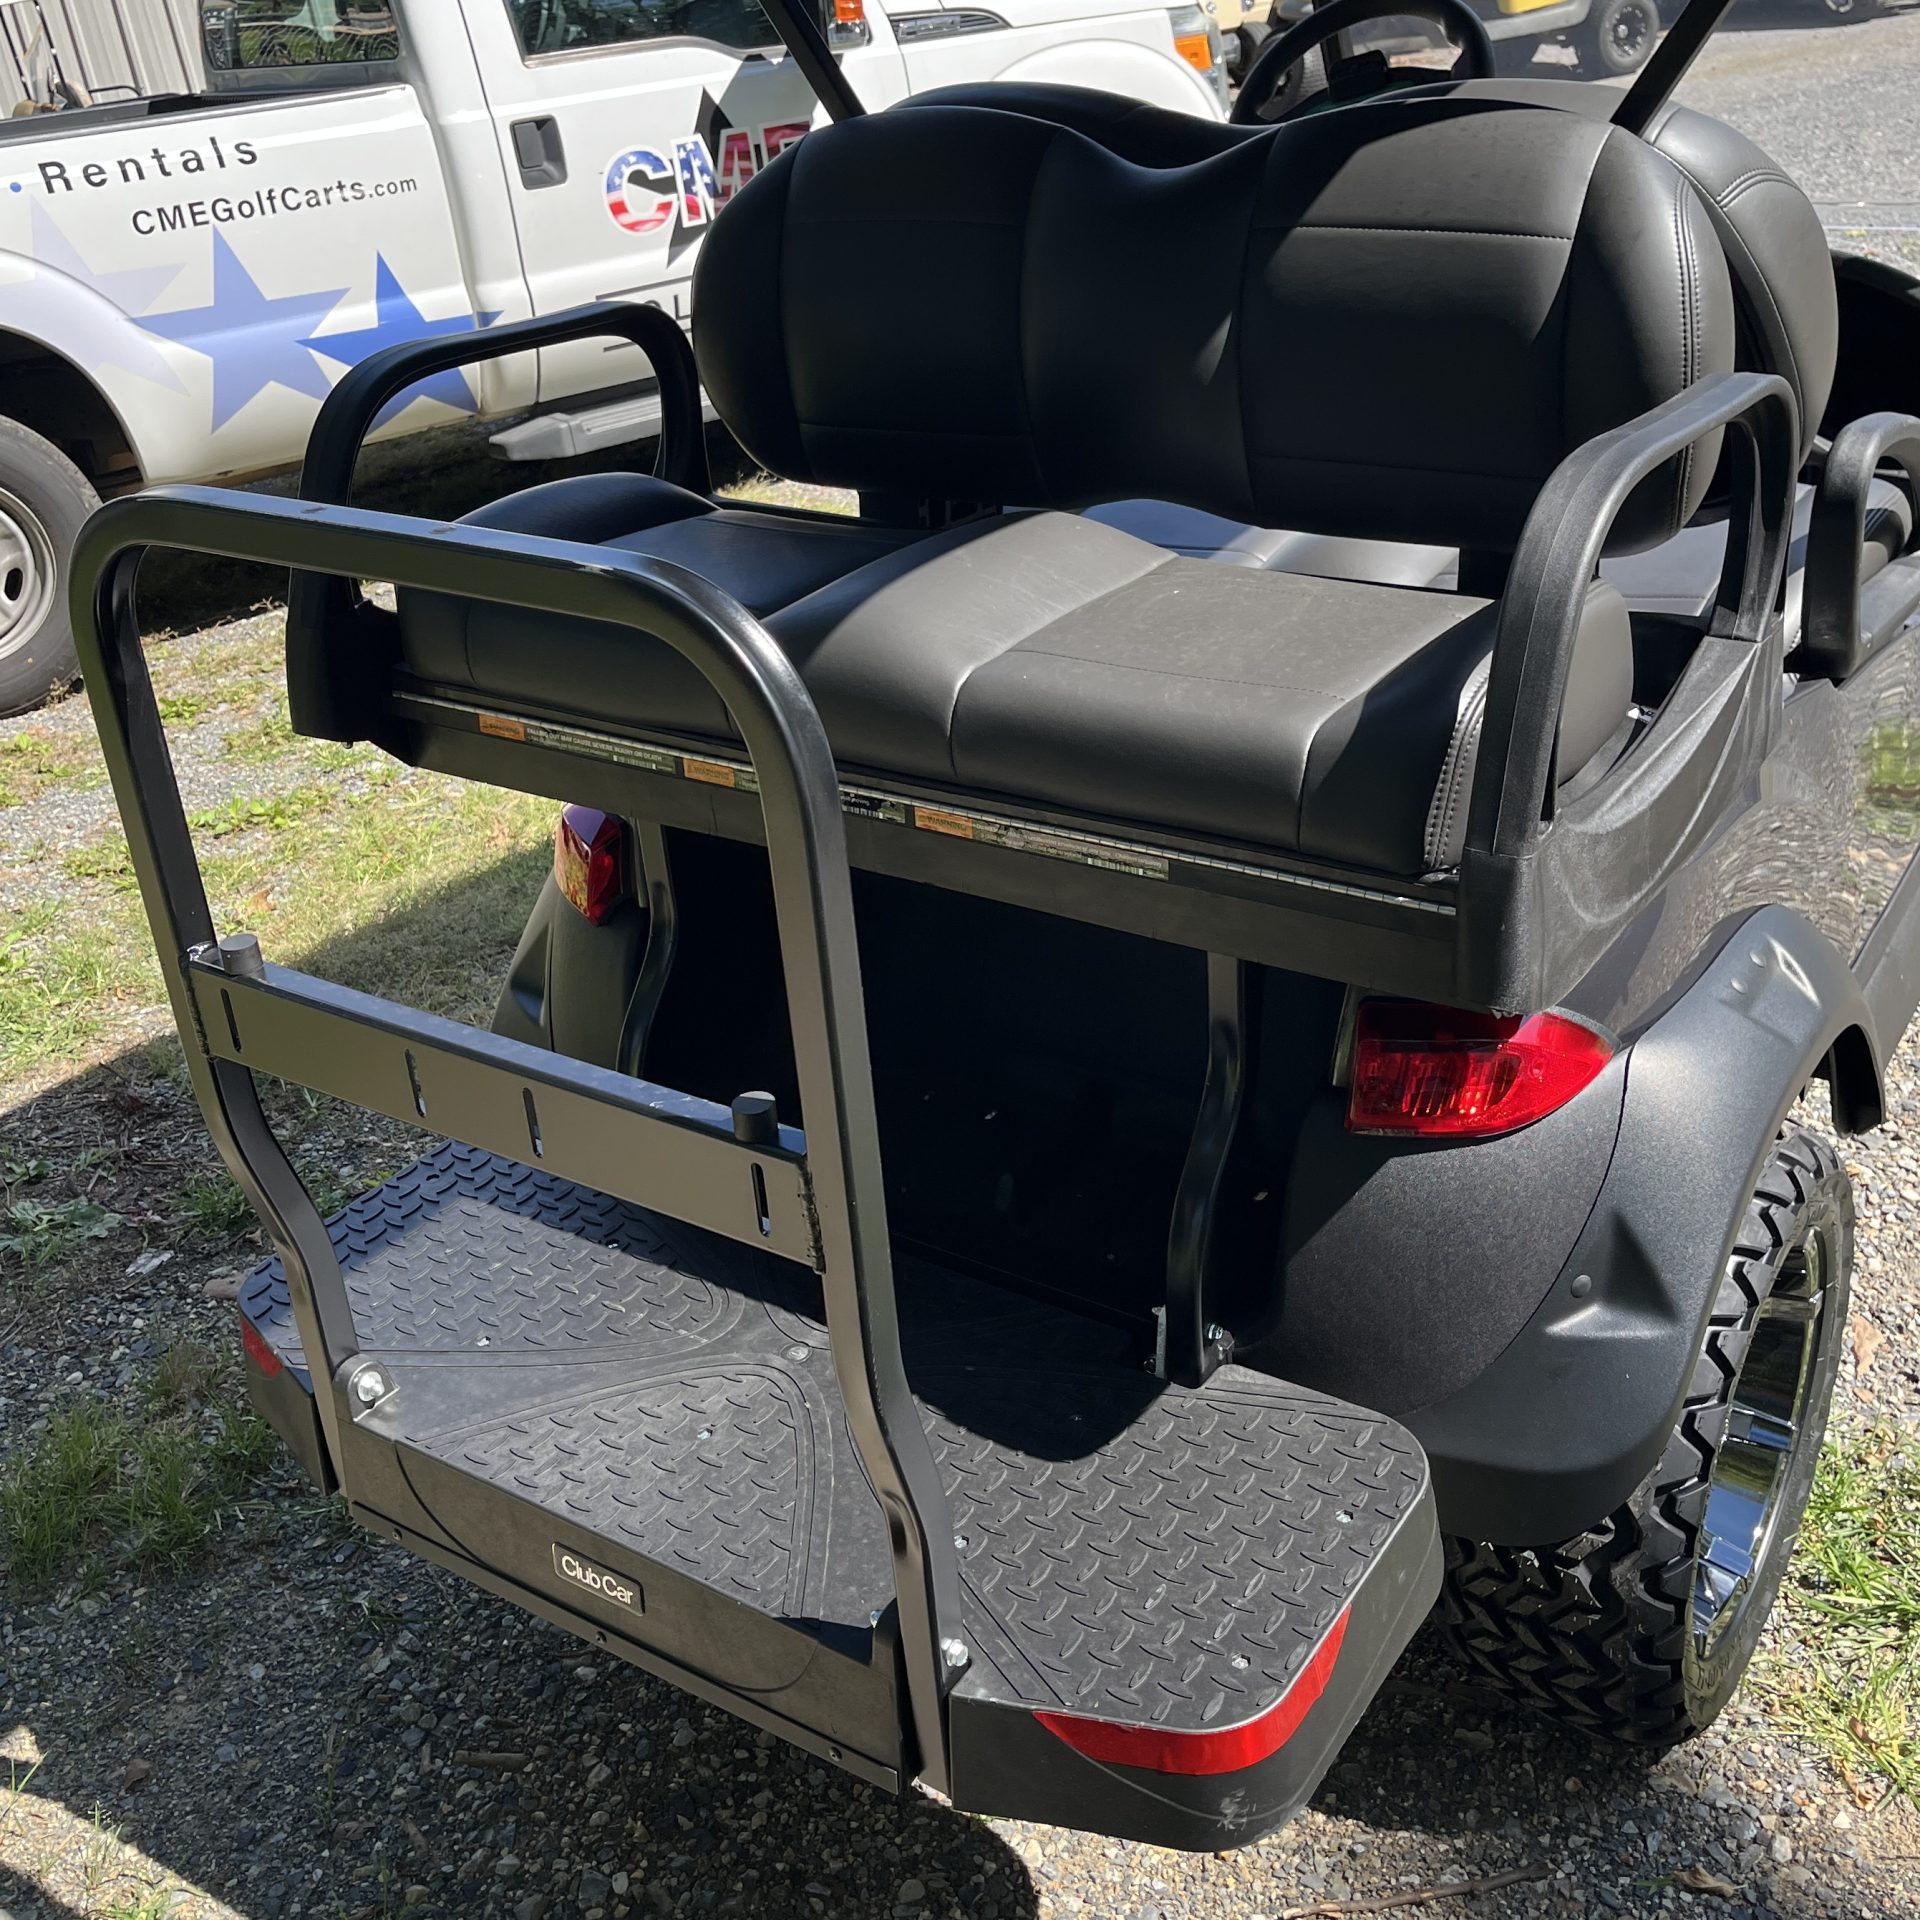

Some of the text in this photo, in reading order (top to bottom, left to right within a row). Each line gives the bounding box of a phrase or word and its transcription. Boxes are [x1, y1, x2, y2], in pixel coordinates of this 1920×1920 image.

[38, 136, 259, 194] Rentals
[132, 176, 418, 235] CMEGolfCarts.com
[560, 733, 572, 743] MAY
[573, 736, 591, 746] CAUSE
[926, 814, 967, 832] WARNING
[562, 1556, 633, 1604] Club Car
